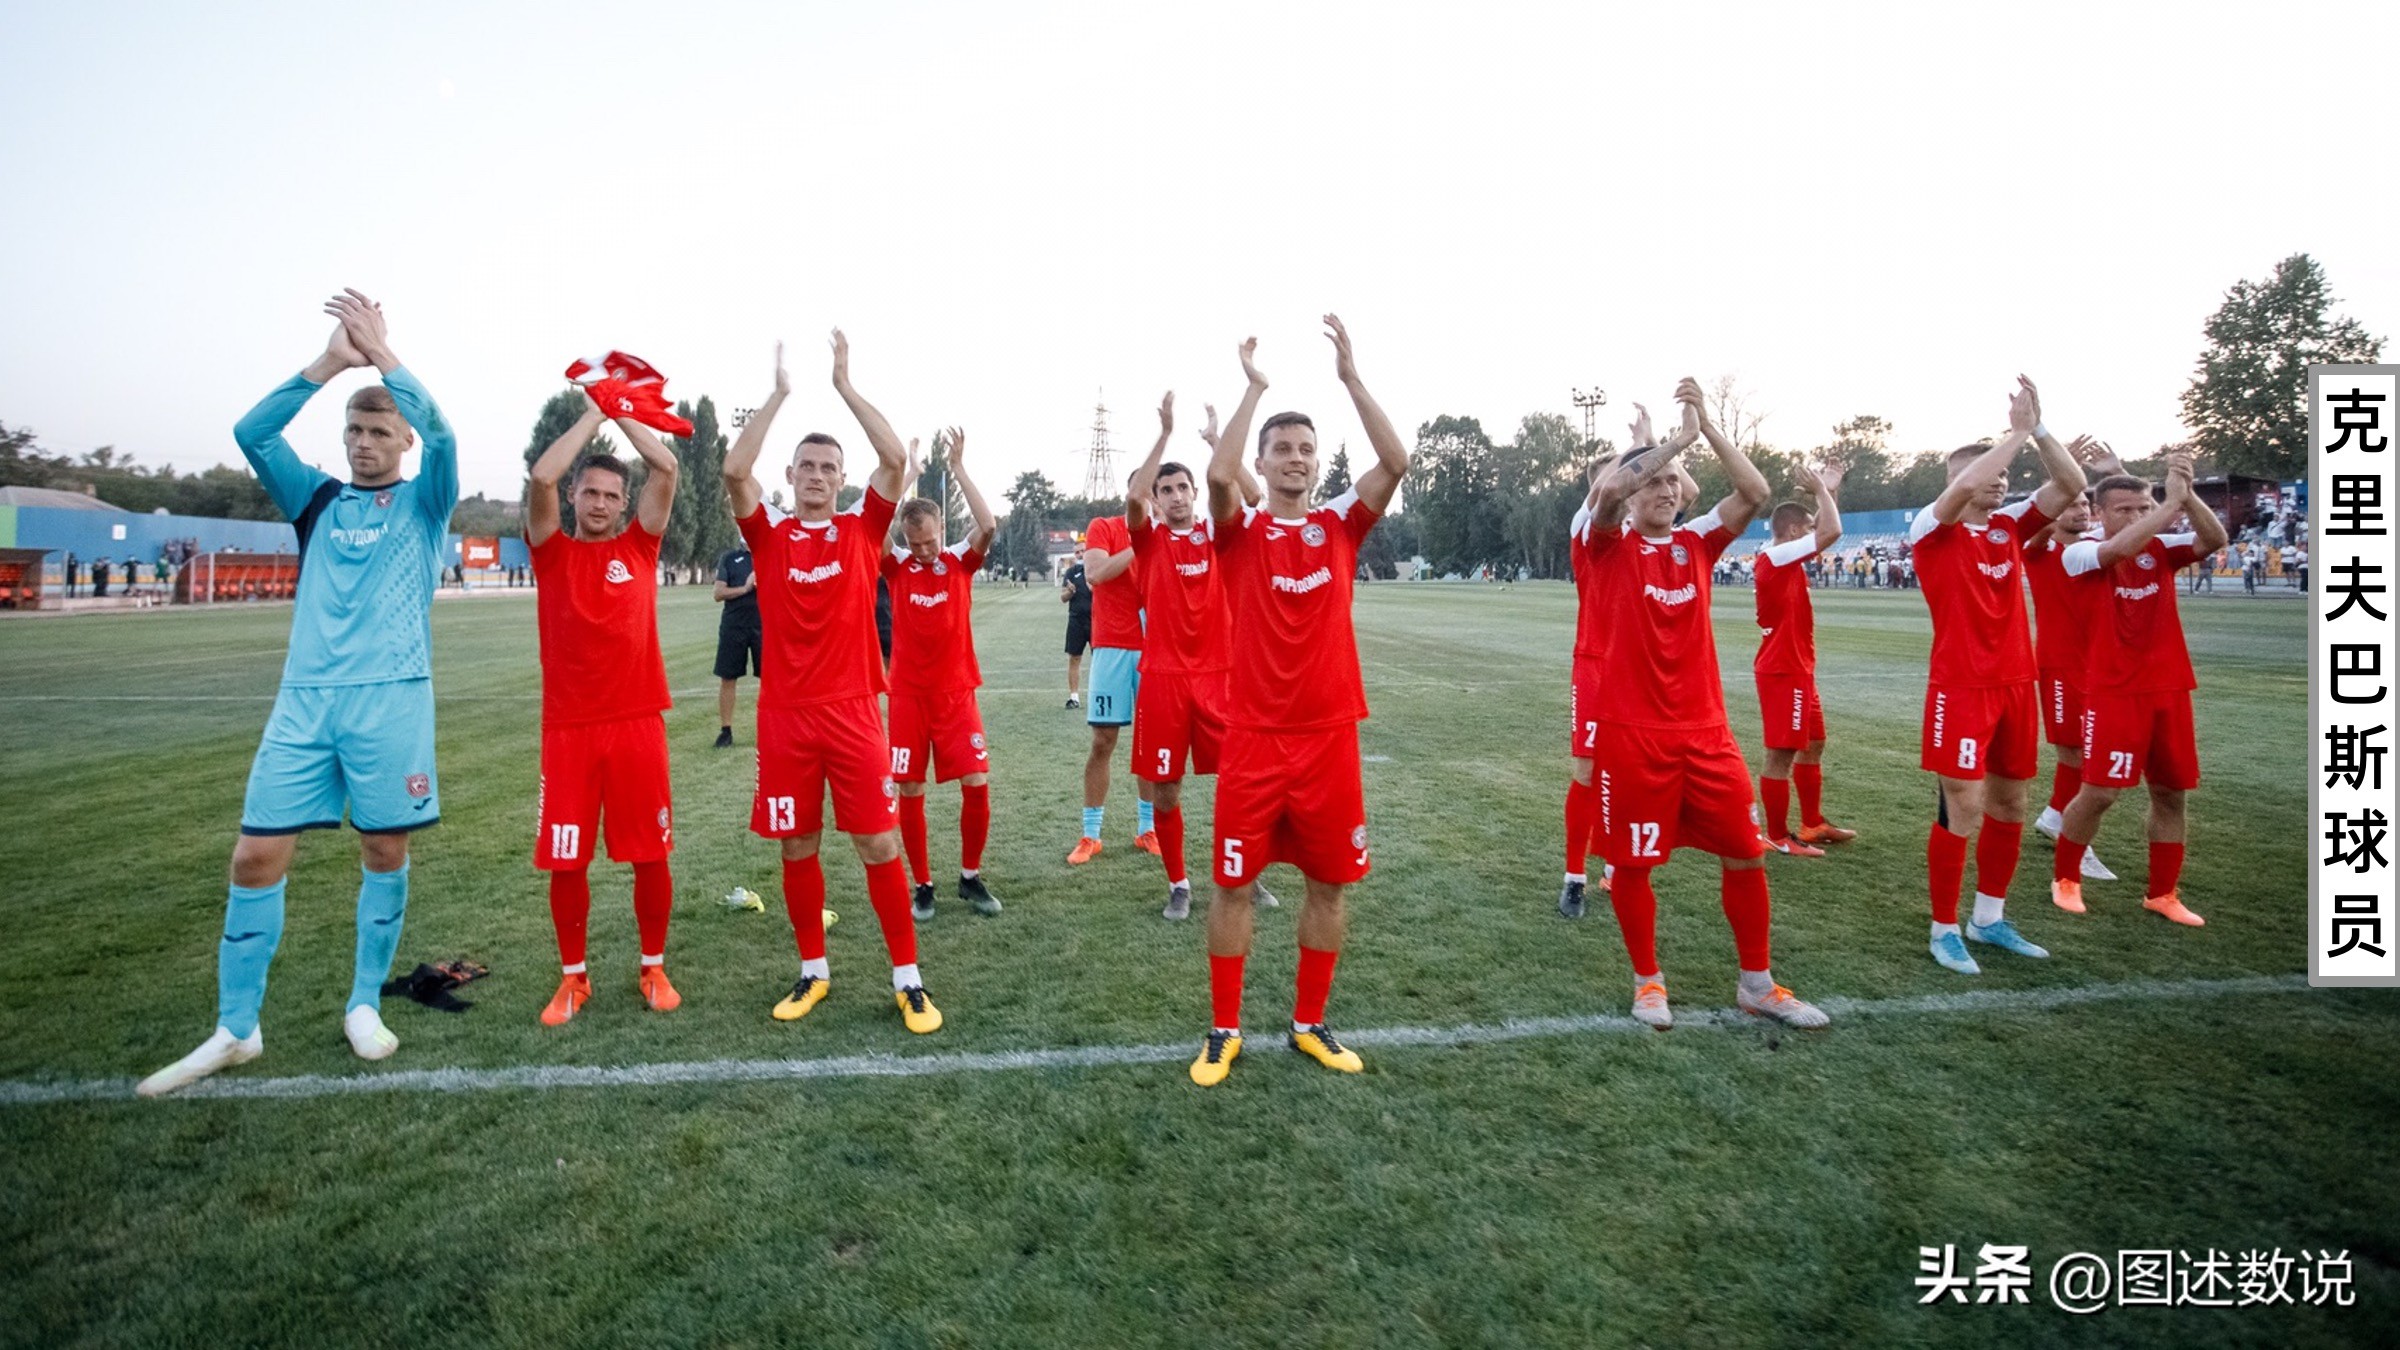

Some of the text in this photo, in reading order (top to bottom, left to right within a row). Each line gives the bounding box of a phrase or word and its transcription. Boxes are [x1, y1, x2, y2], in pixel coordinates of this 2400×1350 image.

[1095, 695, 1112, 717] 31
[1933, 691, 1947, 748] UKRAVIT
[891, 746, 911, 774] 18
[1157, 747, 1171, 776] 3
[1957, 737, 1978, 770] 8
[2107, 751, 2134, 779] 21
[767, 795, 796, 832] 13
[551, 823, 580, 860] 10
[1629, 821, 1661, 858] 12
[1223, 837, 1243, 878] 5
